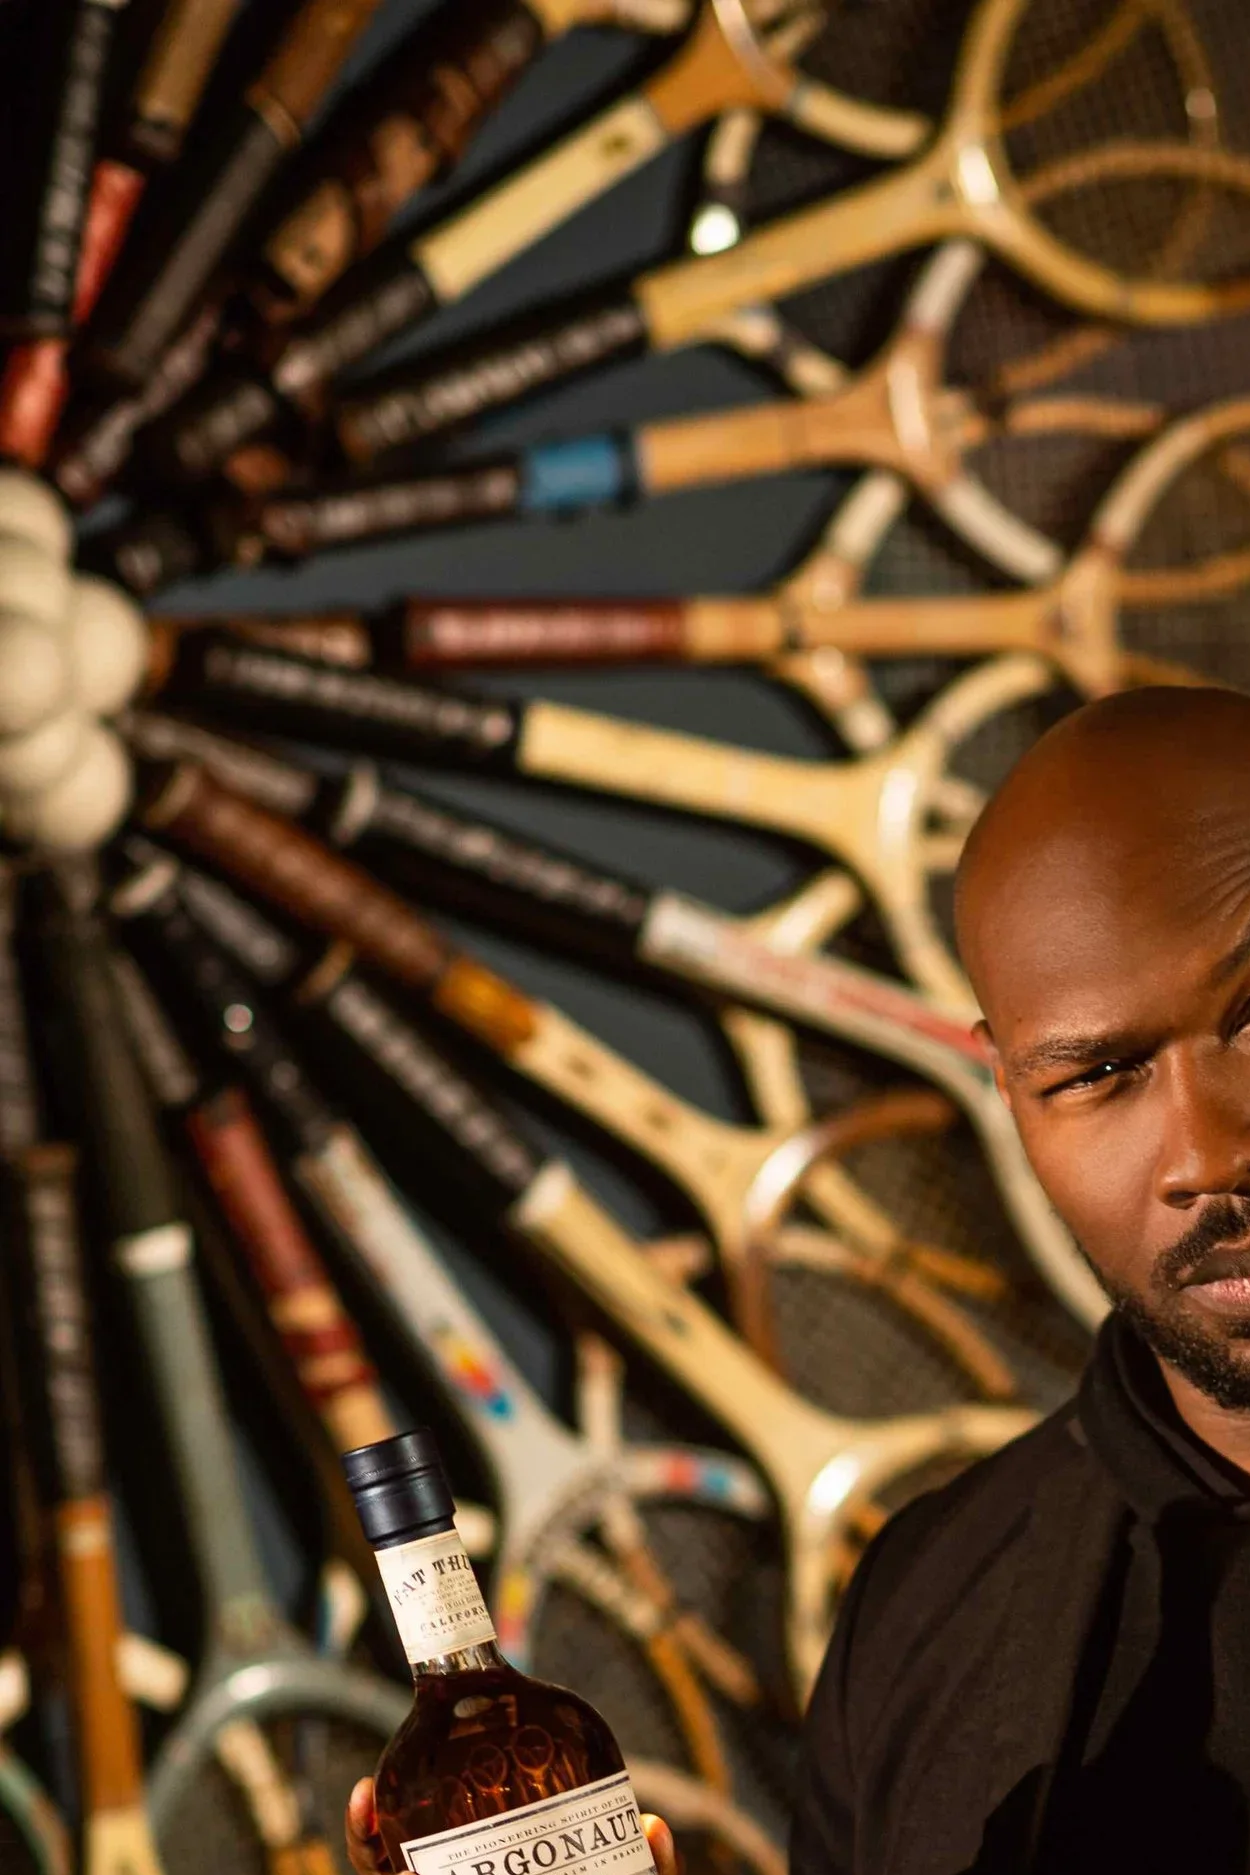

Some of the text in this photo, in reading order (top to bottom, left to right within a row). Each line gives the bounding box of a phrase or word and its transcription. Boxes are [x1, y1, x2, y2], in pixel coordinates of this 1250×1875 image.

[449, 1849, 471, 1861] THE
[475, 1821, 558, 1854] PIONEERING
[560, 1806, 600, 1826] SPIRIT
[601, 1800, 612, 1810] OF
[594, 1857, 607, 1869] IN
